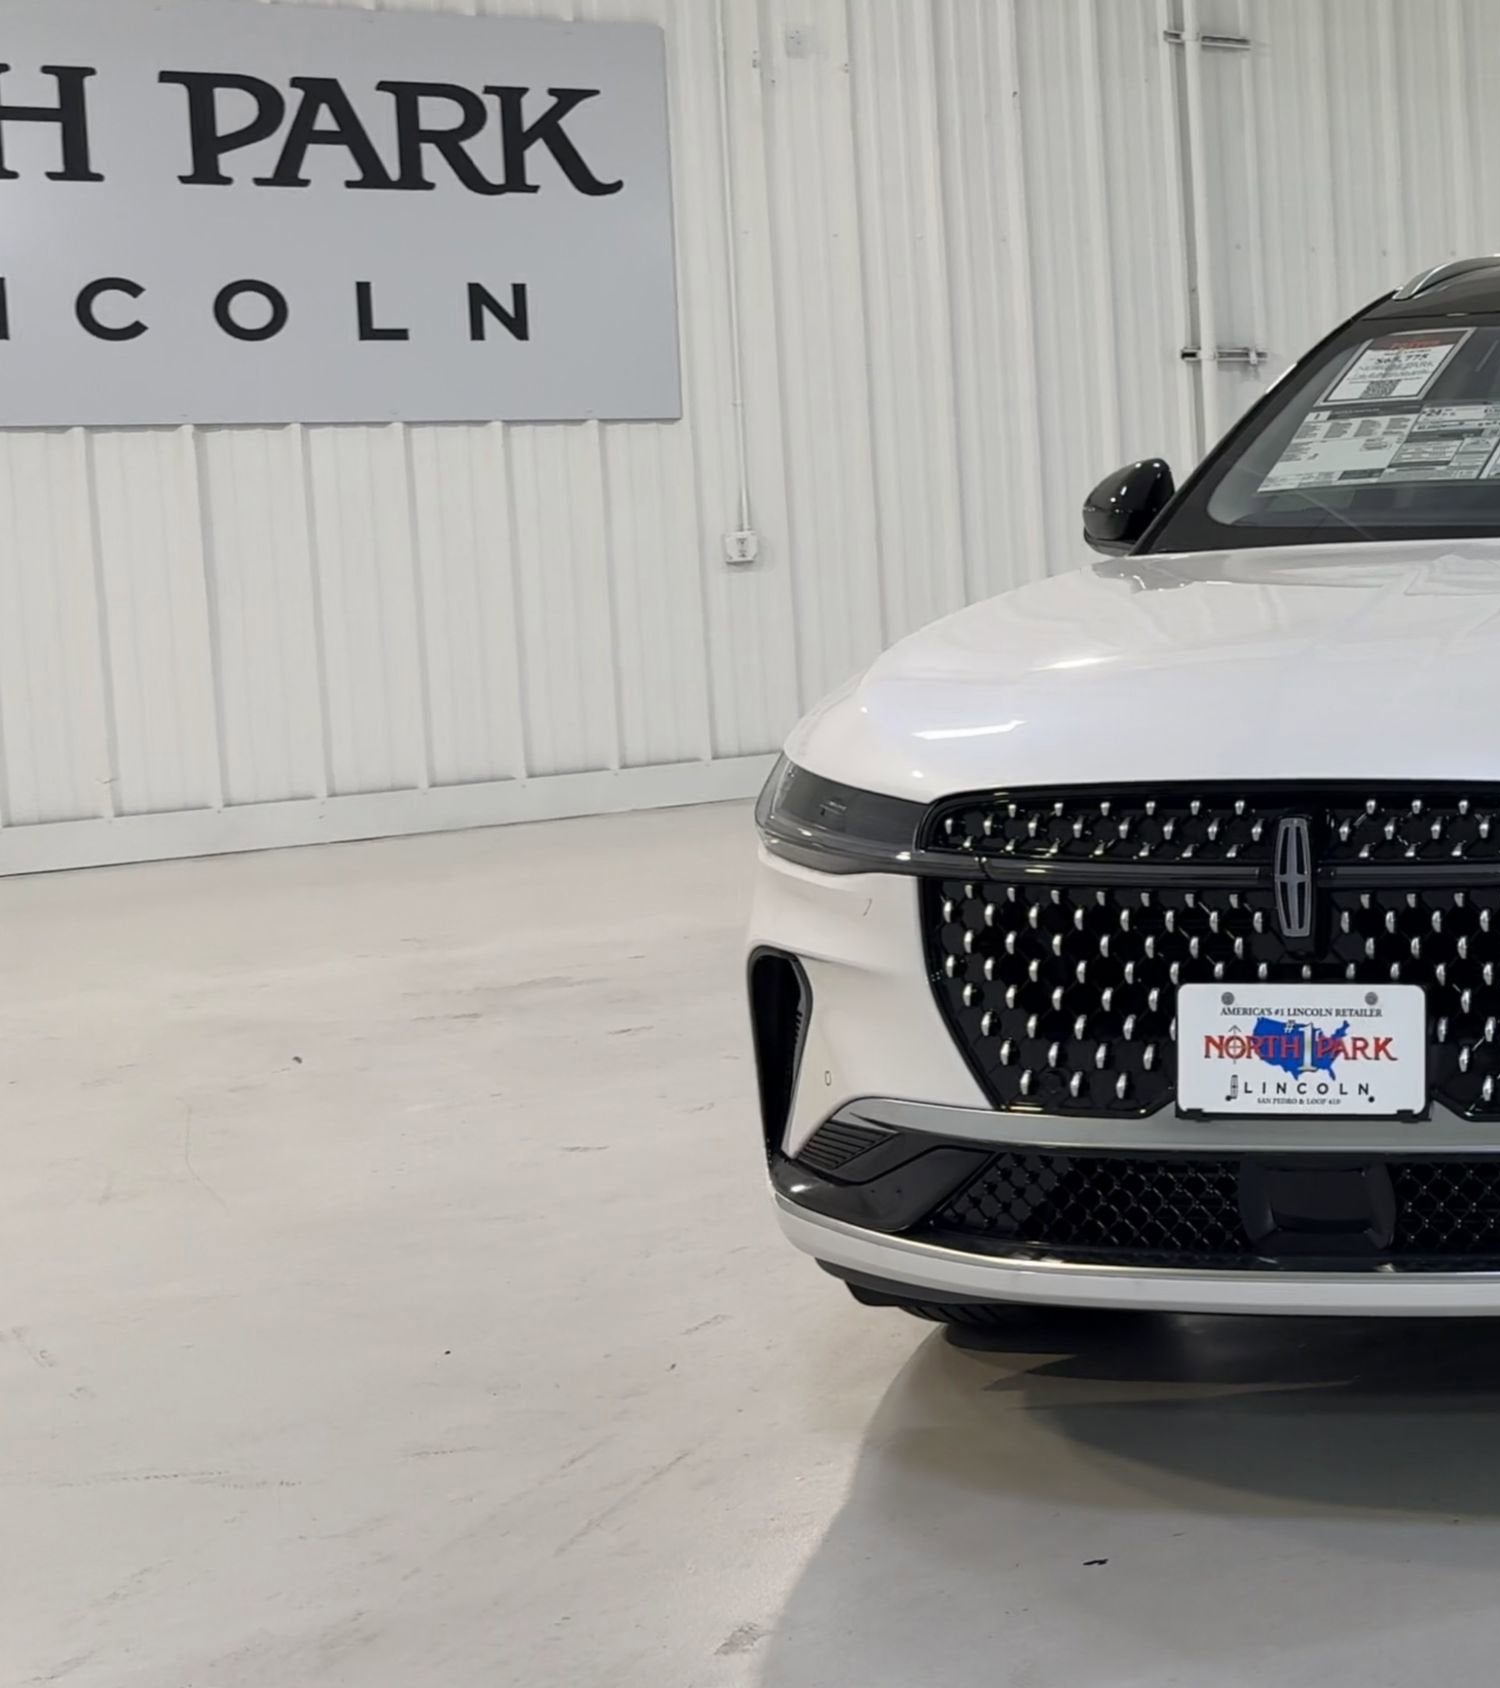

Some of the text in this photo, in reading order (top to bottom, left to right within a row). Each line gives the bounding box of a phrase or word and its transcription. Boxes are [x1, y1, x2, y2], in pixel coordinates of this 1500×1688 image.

[158, 70, 623, 195] PARK
[0, 277, 529, 341] COLN
[1220, 1007, 1383, 1018] AMERICA'S #1 LINCOLN RETAILER
[1204, 1034, 1398, 1061] NORTH PARK
[1244, 1081, 1369, 1096] LINCOLN
[1257, 1097, 1271, 1105] SAN
[1272, 1097, 1298, 1105] PEDRO
